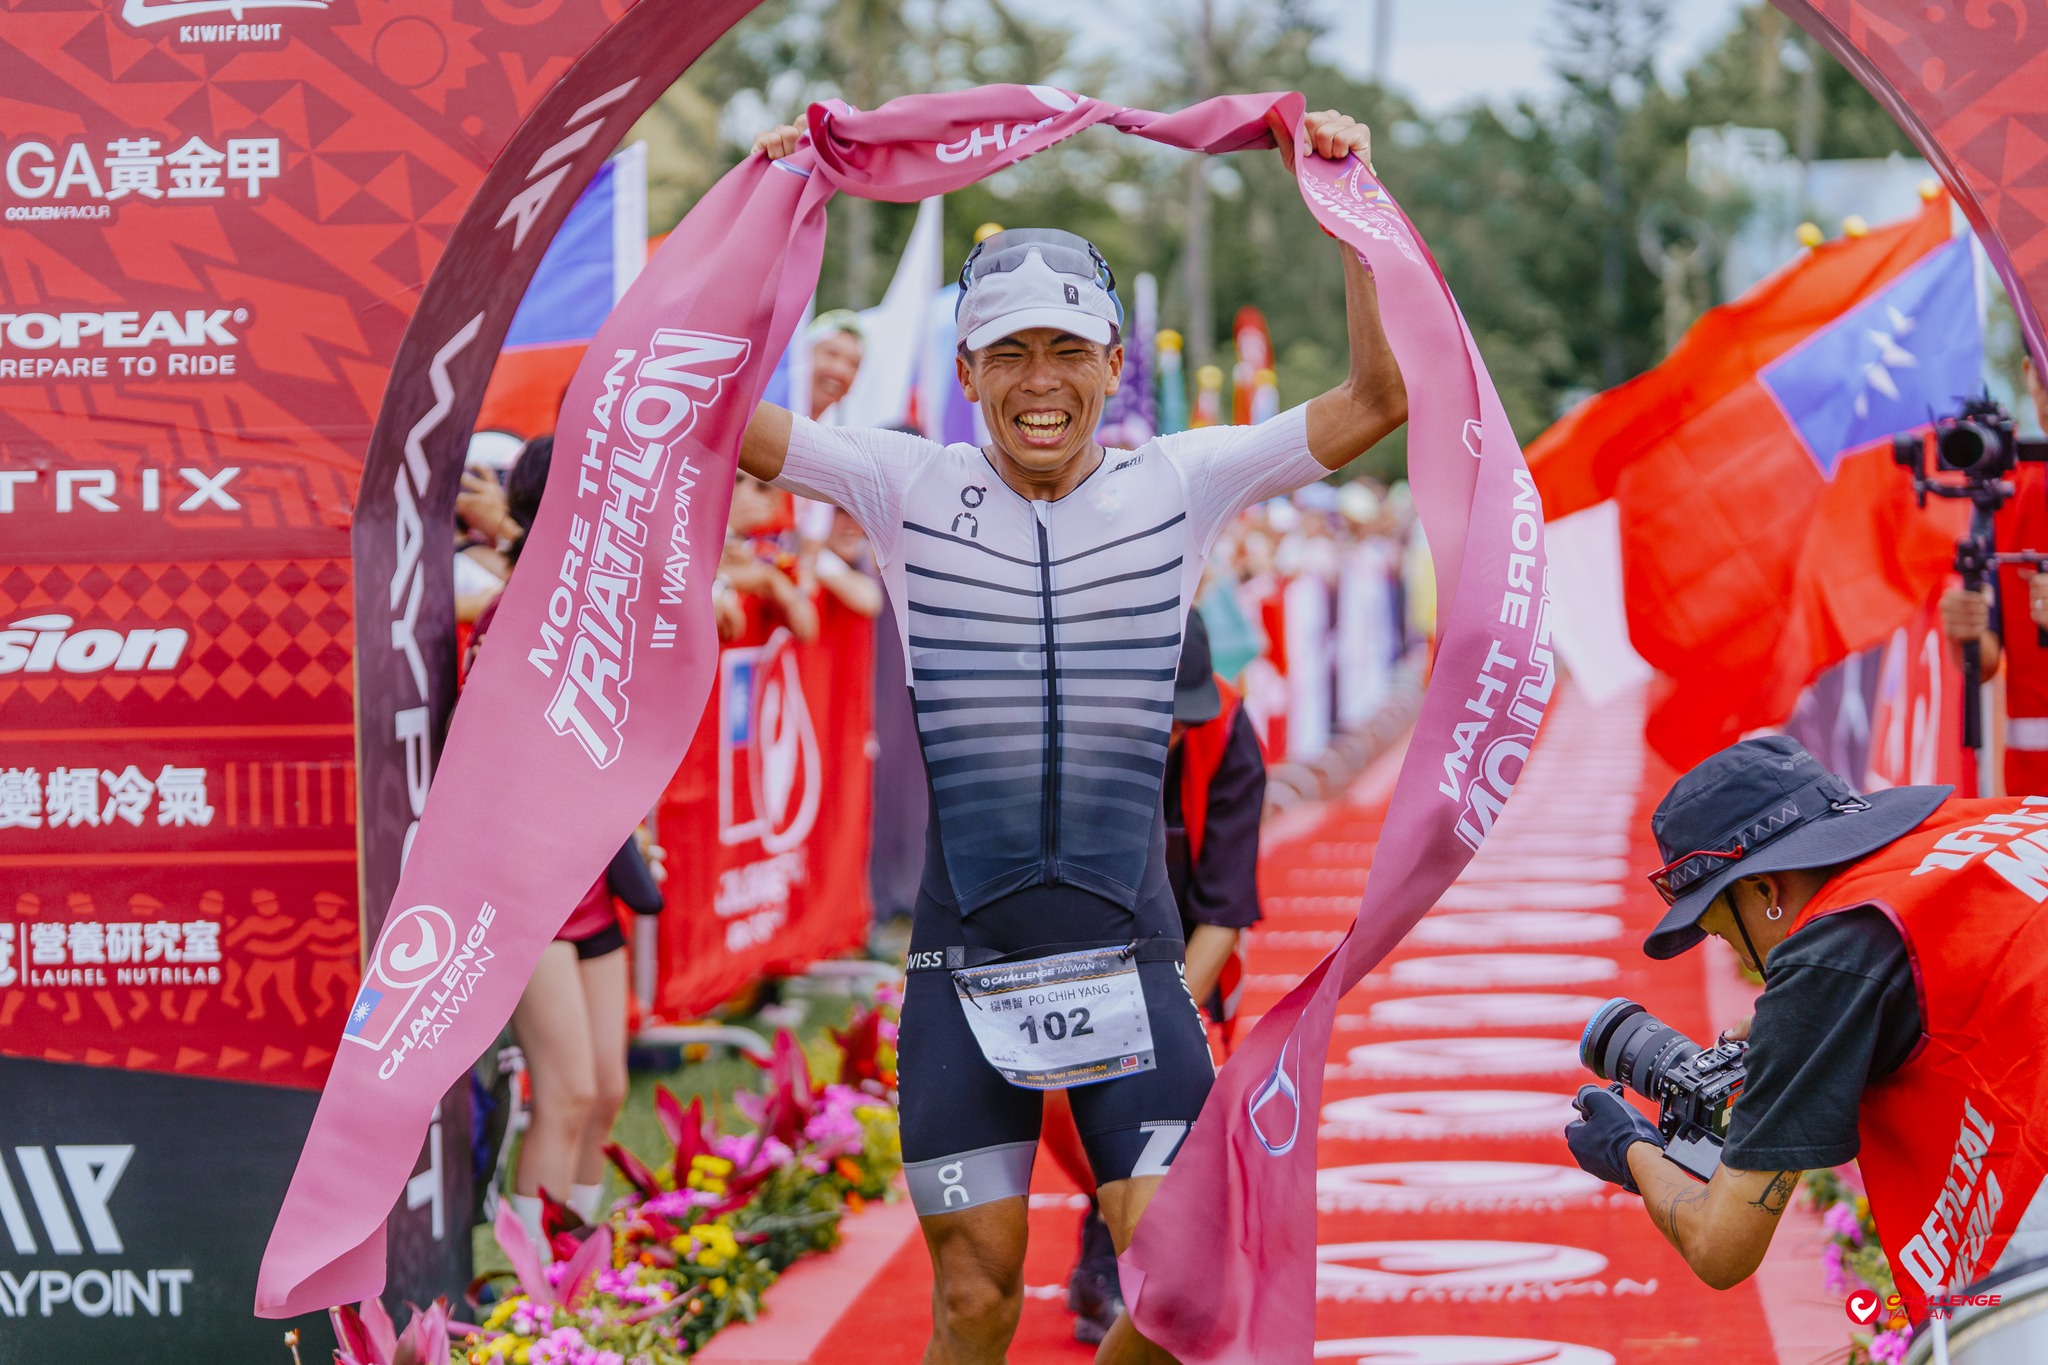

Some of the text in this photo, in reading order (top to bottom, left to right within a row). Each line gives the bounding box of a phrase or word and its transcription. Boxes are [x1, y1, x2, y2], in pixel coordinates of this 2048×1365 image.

[179, 23, 282, 43] KIWIFRUIT
[118, 356, 157, 377] TO
[168, 353, 236, 376] RIDE
[527, 347, 638, 679] MORE THAN
[659, 456, 702, 605] WAYPOINT
[544, 327, 752, 770] TRIATHLON
[0, 764, 215, 829] 變頻冷氣
[30, 920, 222, 965] 營養研究室
[31, 967, 221, 988] LAUREL NUTRILAB
[378, 901, 497, 1082] CHALLENGE
[990, 962, 1095, 985] CHALLENGE TAIWAN
[1028, 983, 1111, 1006] PO CHIH YANG
[417, 945, 496, 1052] TAIWAN
[1019, 1006, 1095, 1045] 102
[1026, 1073, 1045, 1081] MORE
[1047, 1071, 1066, 1080] THAN
[1067, 1063, 1108, 1078] TRIATHLON
